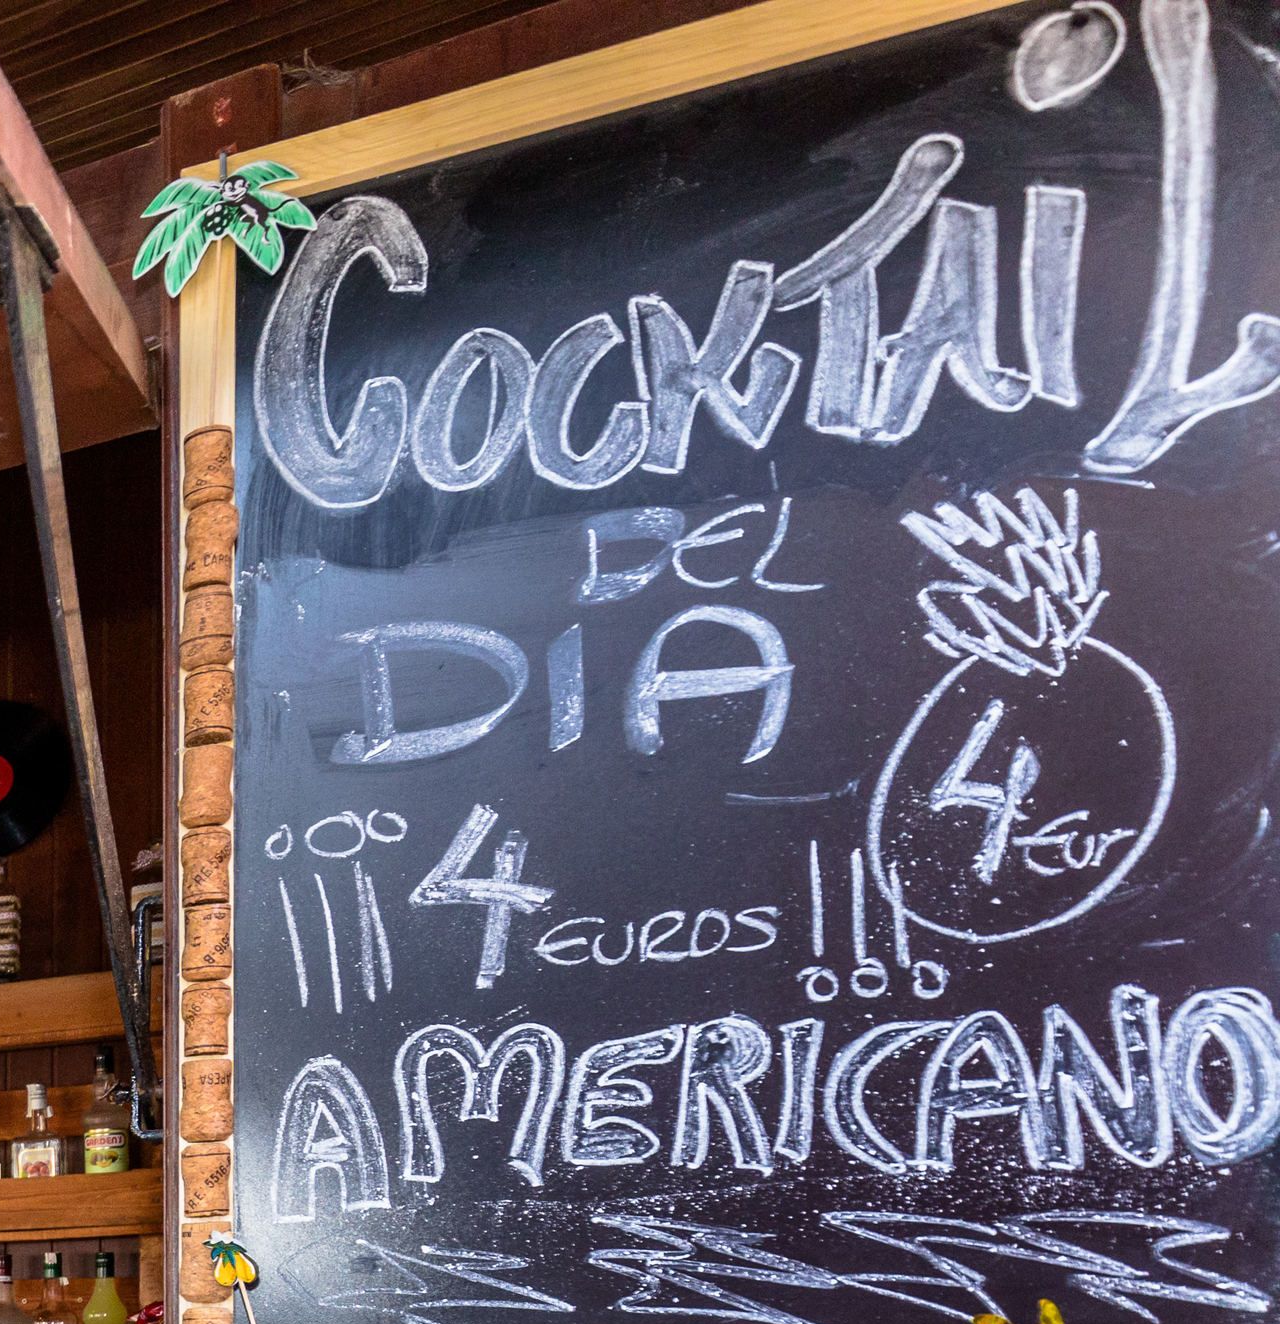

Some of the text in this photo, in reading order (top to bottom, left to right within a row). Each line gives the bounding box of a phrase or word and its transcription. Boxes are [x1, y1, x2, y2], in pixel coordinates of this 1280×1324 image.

[579, 494, 827, 603] DEL
[328, 602, 797, 767] DIA
[927, 697, 1038, 885] 4
[409, 803, 557, 990] 4
[534, 903, 781, 968] EUROS
[270, 983, 1280, 1224] AMERICANO
